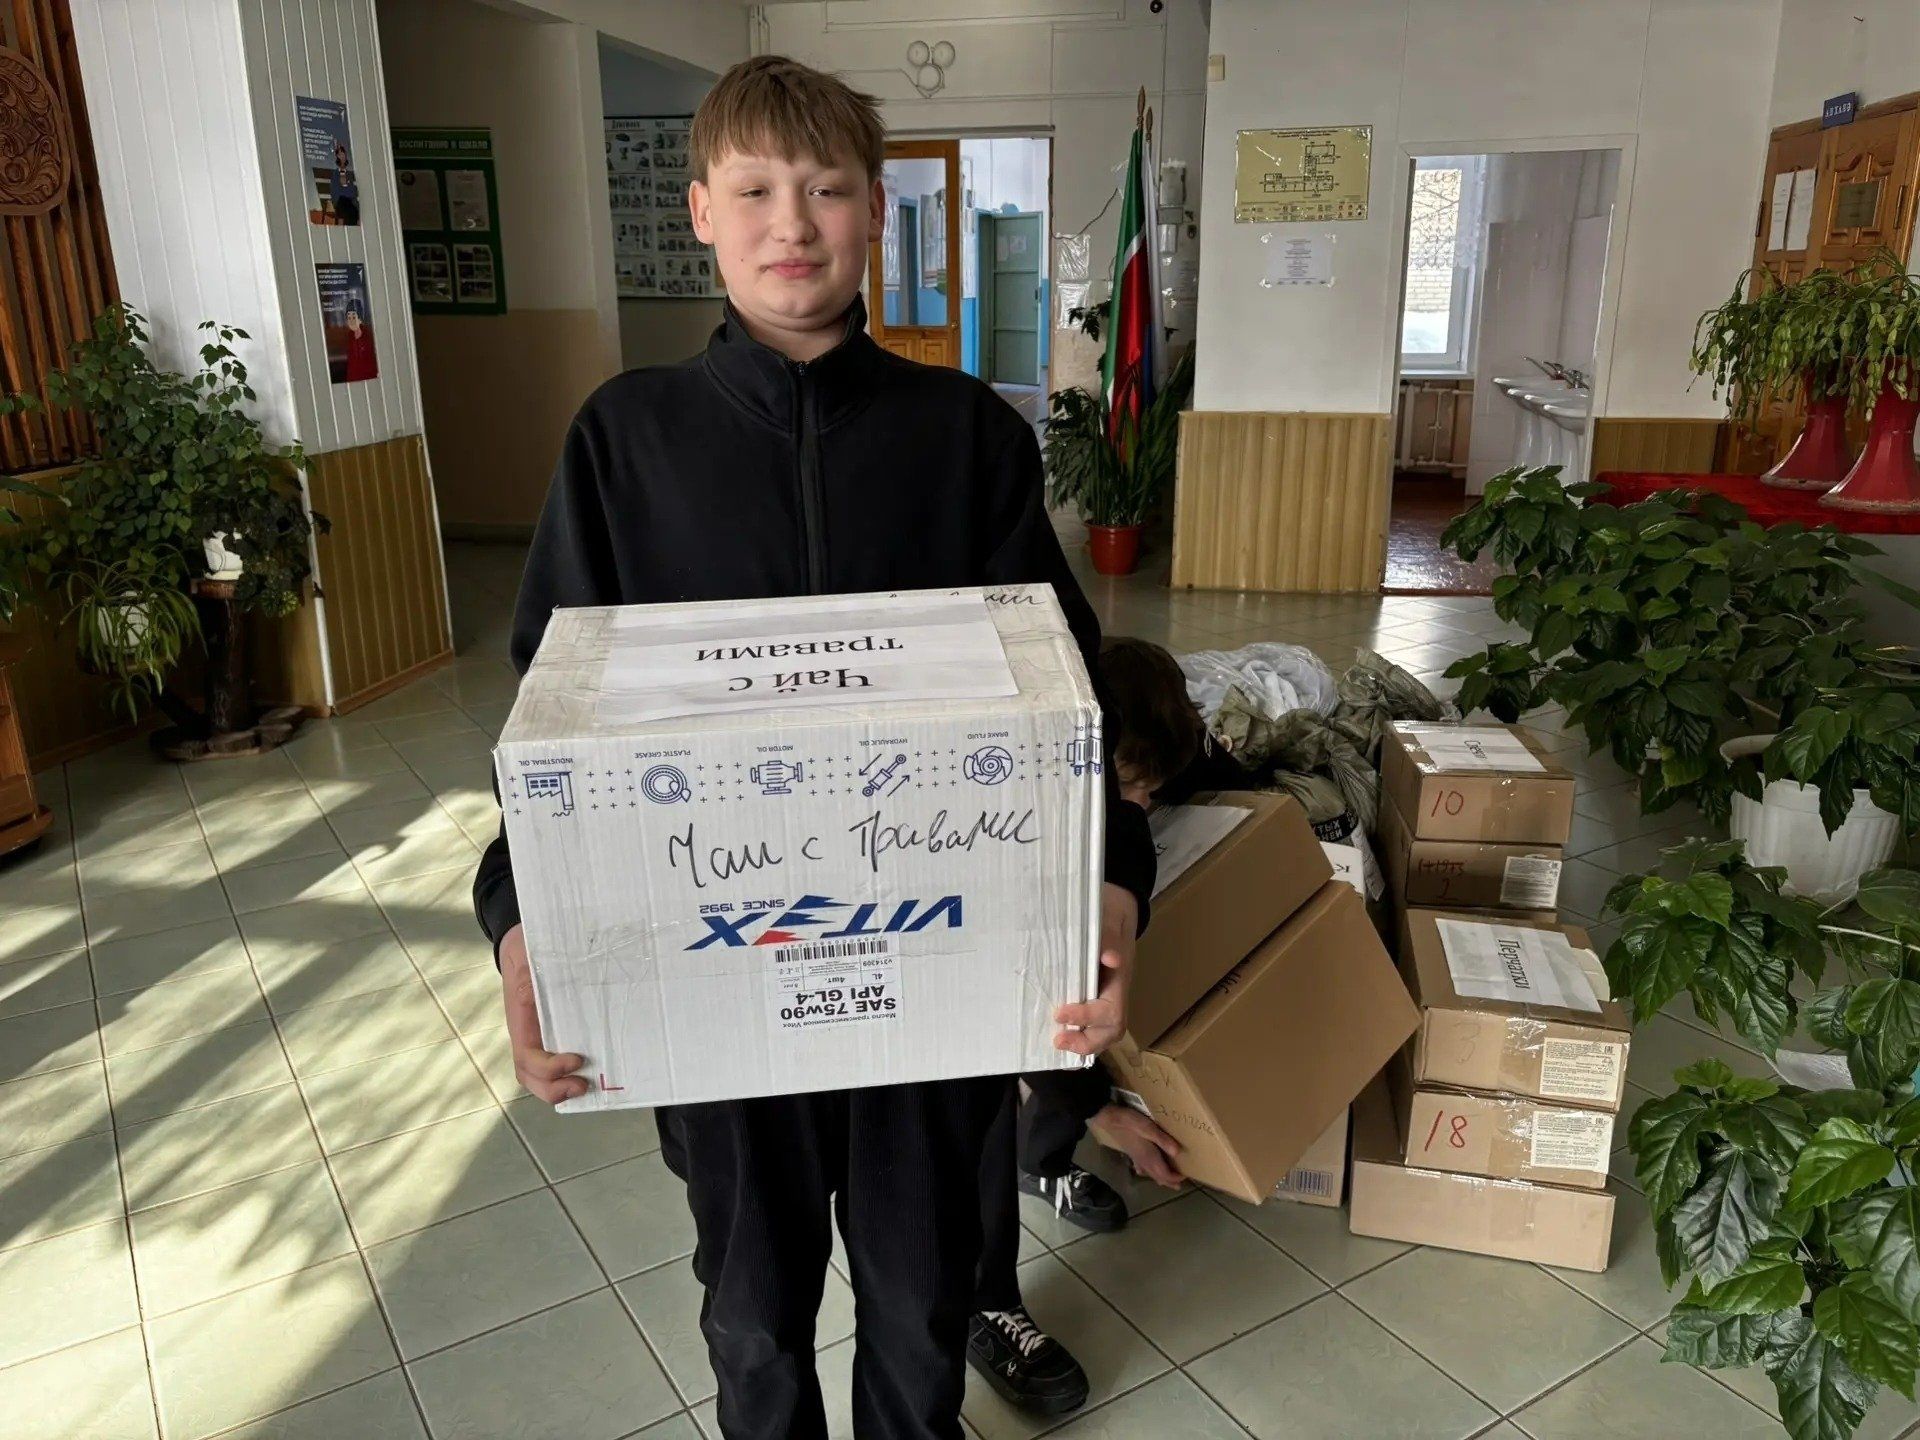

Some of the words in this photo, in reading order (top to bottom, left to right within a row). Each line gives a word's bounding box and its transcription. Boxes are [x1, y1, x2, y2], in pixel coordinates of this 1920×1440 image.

[694, 636, 904, 663] травами
[728, 674, 754, 693] с
[777, 667, 873, 694] Чай
[873, 738, 908, 746] HYDRAULIC
[532, 757, 573, 766] INDUSTRIAL
[634, 751, 662, 759] GREASE
[663, 750, 691, 758] PLASTIC
[518, 759, 530, 767] OIL
[1430, 789, 1465, 817] 10
[801, 836, 825, 861] с
[699, 902, 735, 914] 1992
[742, 898, 786, 911] SINCE
[682, 894, 962, 951] VITEX
[1497, 939, 1531, 990] Перчатки
[795, 989, 843, 1005] GL-4
[850, 985, 885, 1000] API
[780, 1002, 849, 1020] 75w90
[855, 997, 896, 1013] SAE
[872, 1012, 896, 1020] Масло
[1423, 1110, 1467, 1152] 18
